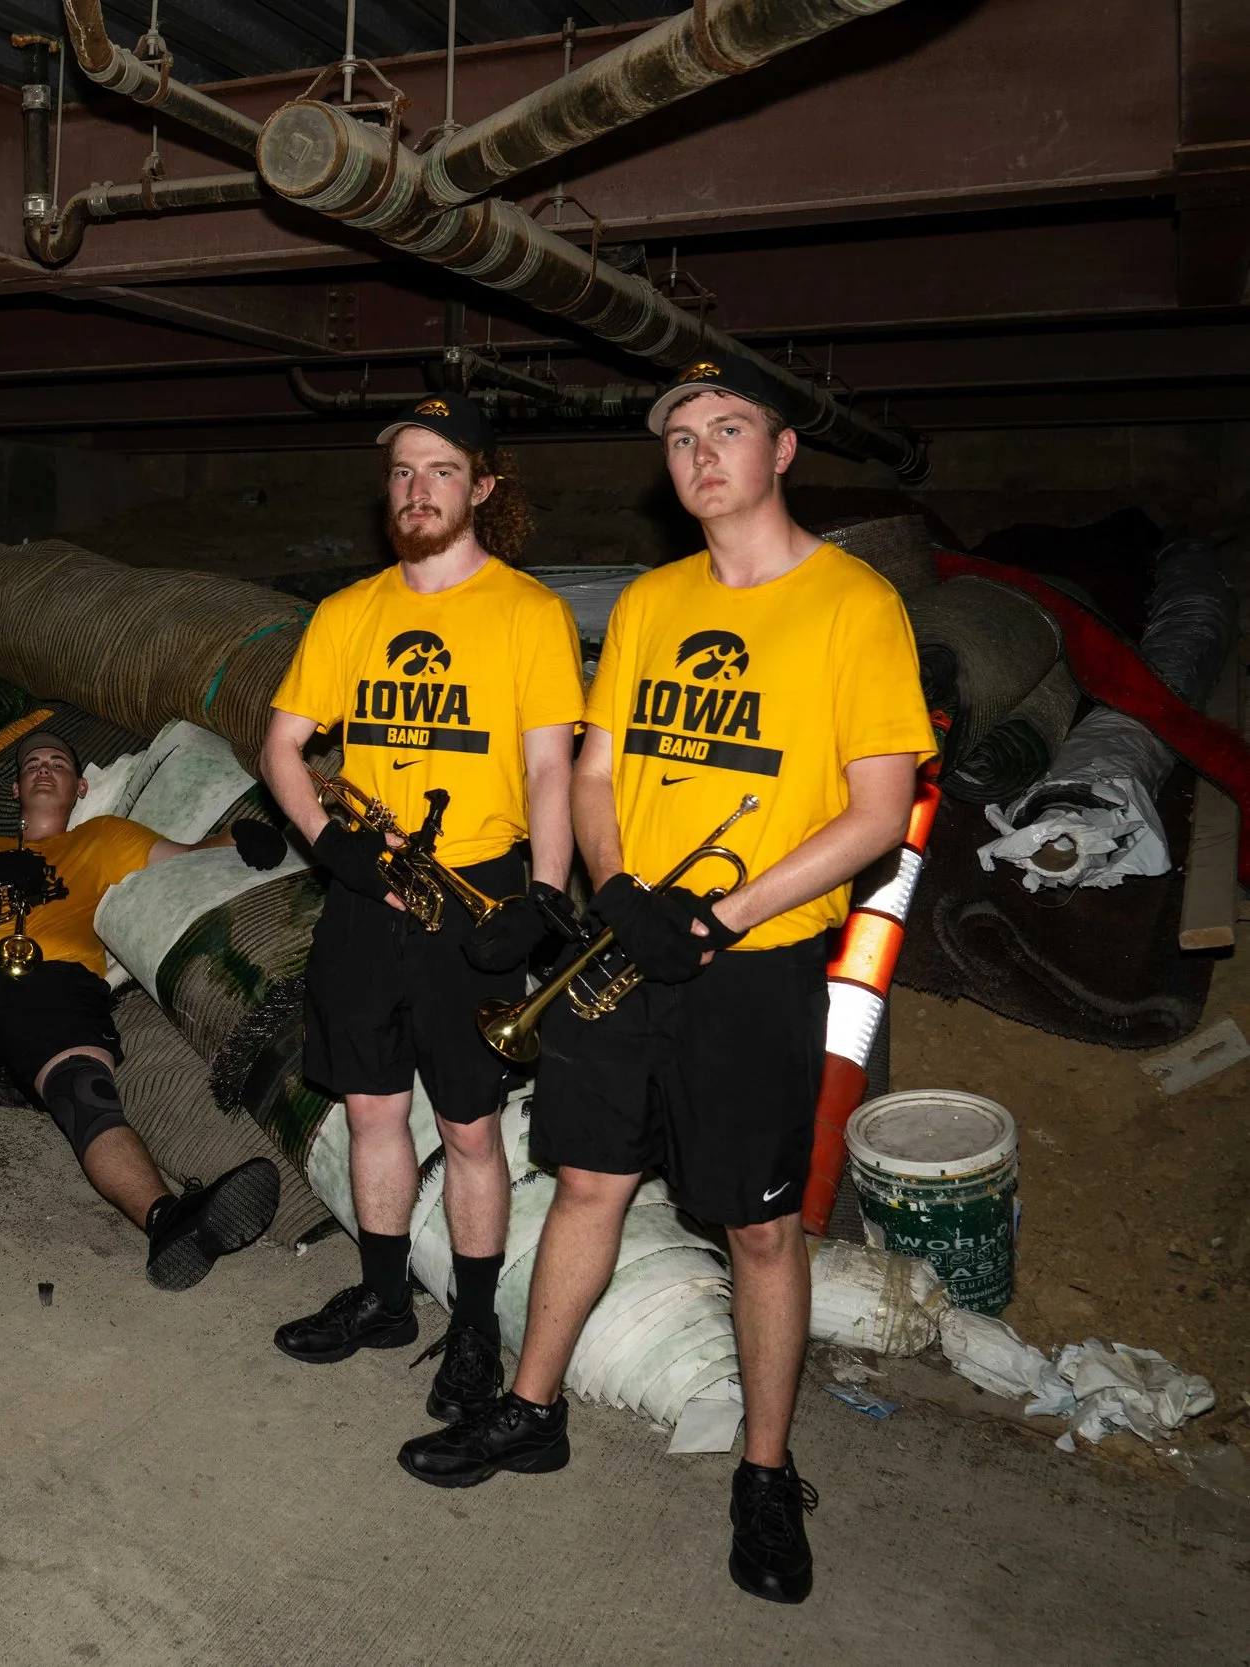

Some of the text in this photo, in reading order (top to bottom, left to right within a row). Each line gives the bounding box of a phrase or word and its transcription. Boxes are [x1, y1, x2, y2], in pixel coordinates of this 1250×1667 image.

[355, 680, 470, 725] IOWA
[633, 679, 761, 740] IOWA
[387, 727, 430, 746] BAND
[658, 736, 710, 761] BAND
[895, 1223, 1008, 1250] WORLD
